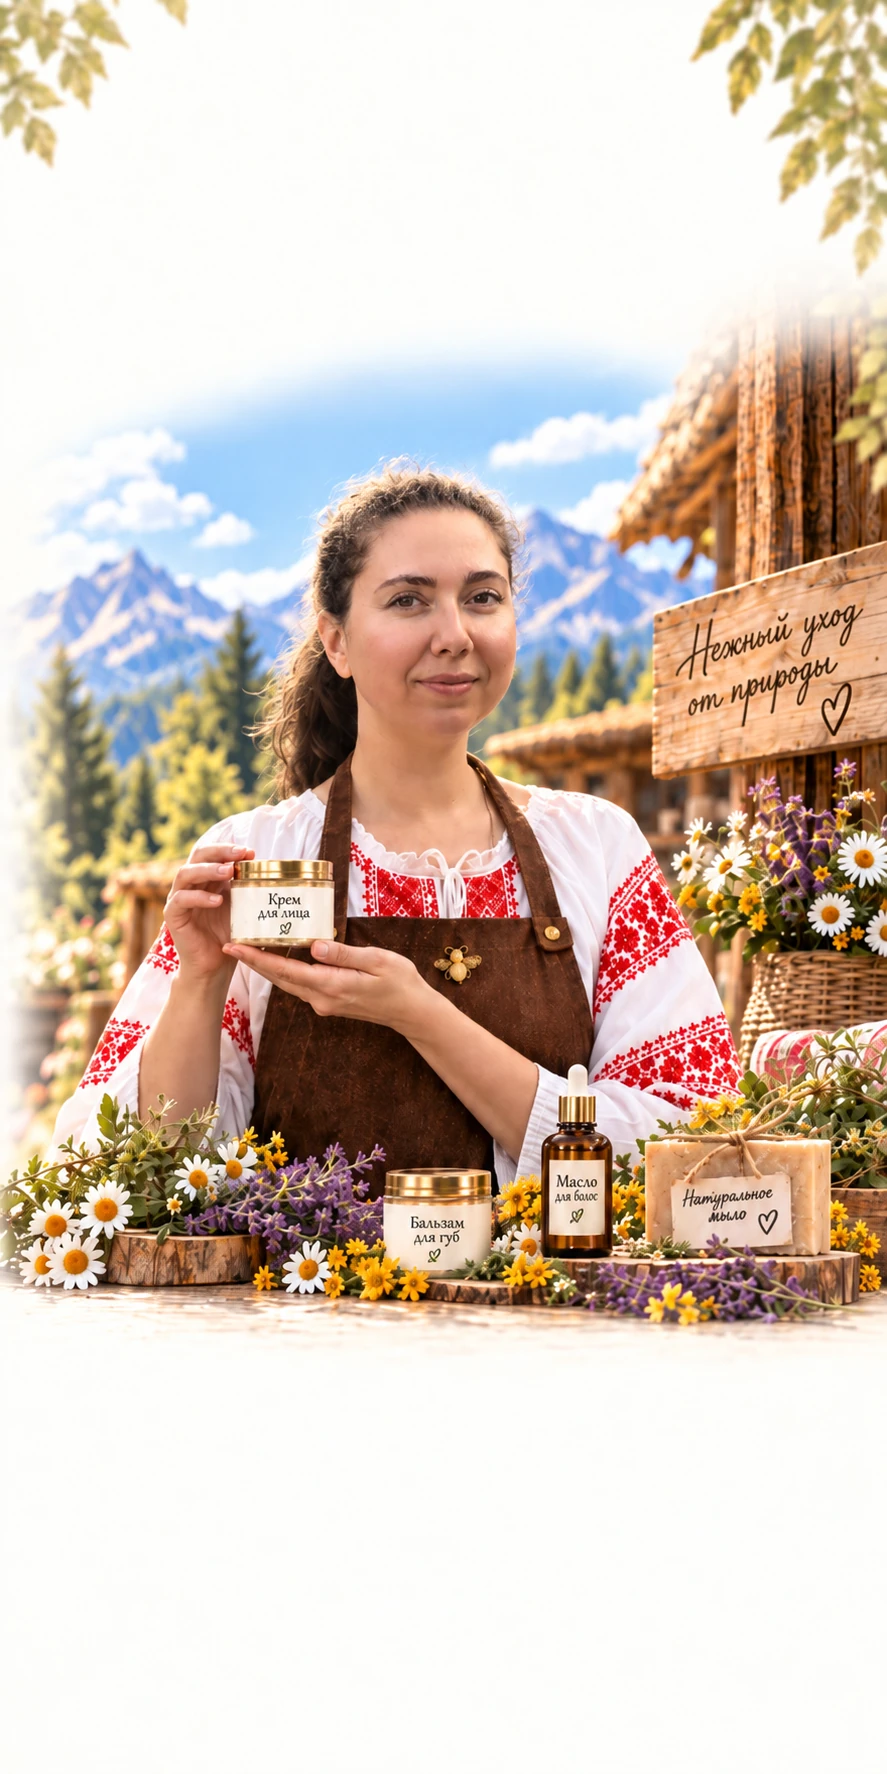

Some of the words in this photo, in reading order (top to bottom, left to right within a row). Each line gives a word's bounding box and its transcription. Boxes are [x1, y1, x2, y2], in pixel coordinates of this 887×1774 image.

[676, 613, 793, 680] Нежный
[801, 604, 864, 657] уход
[688, 692, 724, 716] от
[730, 657, 838, 727] природы
[268, 893, 301, 909] Крем
[258, 910, 278, 920] для
[281, 910, 310, 920] лица
[556, 1174, 598, 1188] Масло
[555, 1193, 571, 1204] для
[682, 1188, 773, 1211] Натуральное
[410, 1216, 464, 1229] Бальзам
[708, 1210, 746, 1223] мыло
[413, 1234, 435, 1245] для
[439, 1230, 460, 1247] губ
